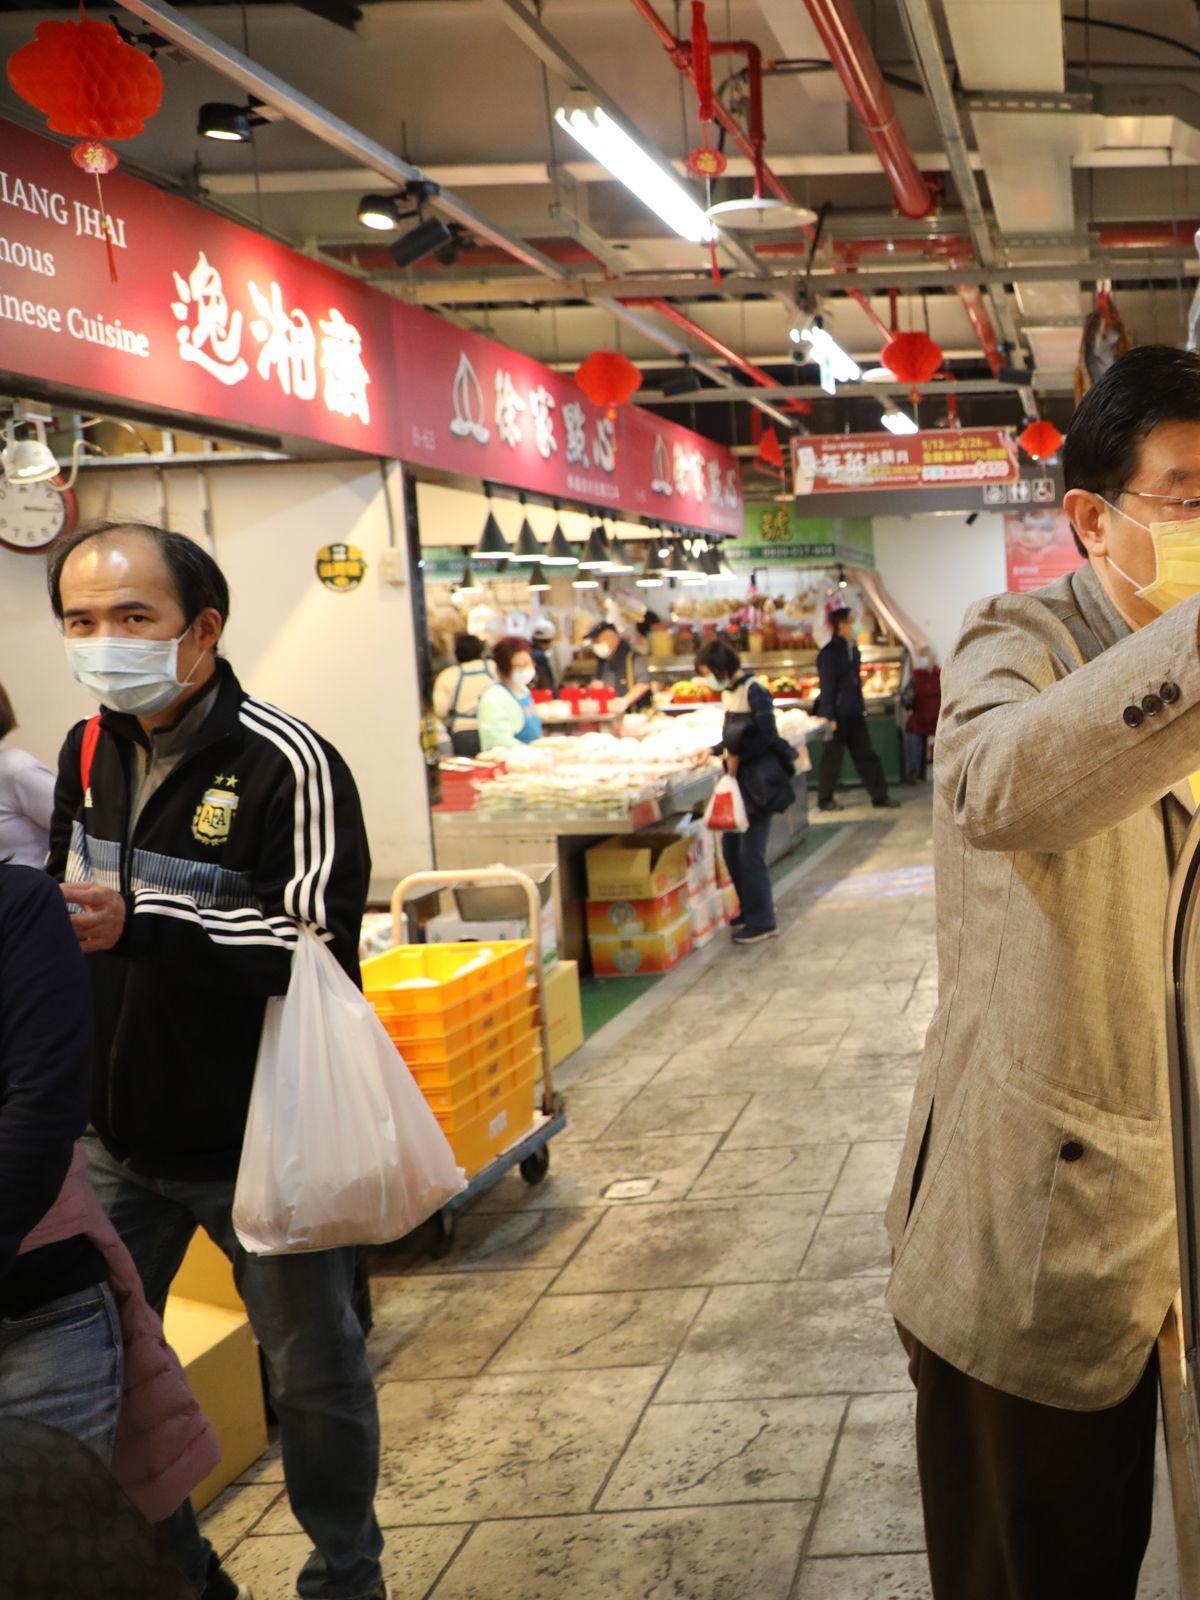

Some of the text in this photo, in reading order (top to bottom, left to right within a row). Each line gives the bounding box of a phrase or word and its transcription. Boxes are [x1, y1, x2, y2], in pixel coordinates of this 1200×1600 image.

[74, 200, 128, 249] JHAI
[67, 308, 150, 358] Cuisine
[494, 367, 616, 473] 徐家點心
